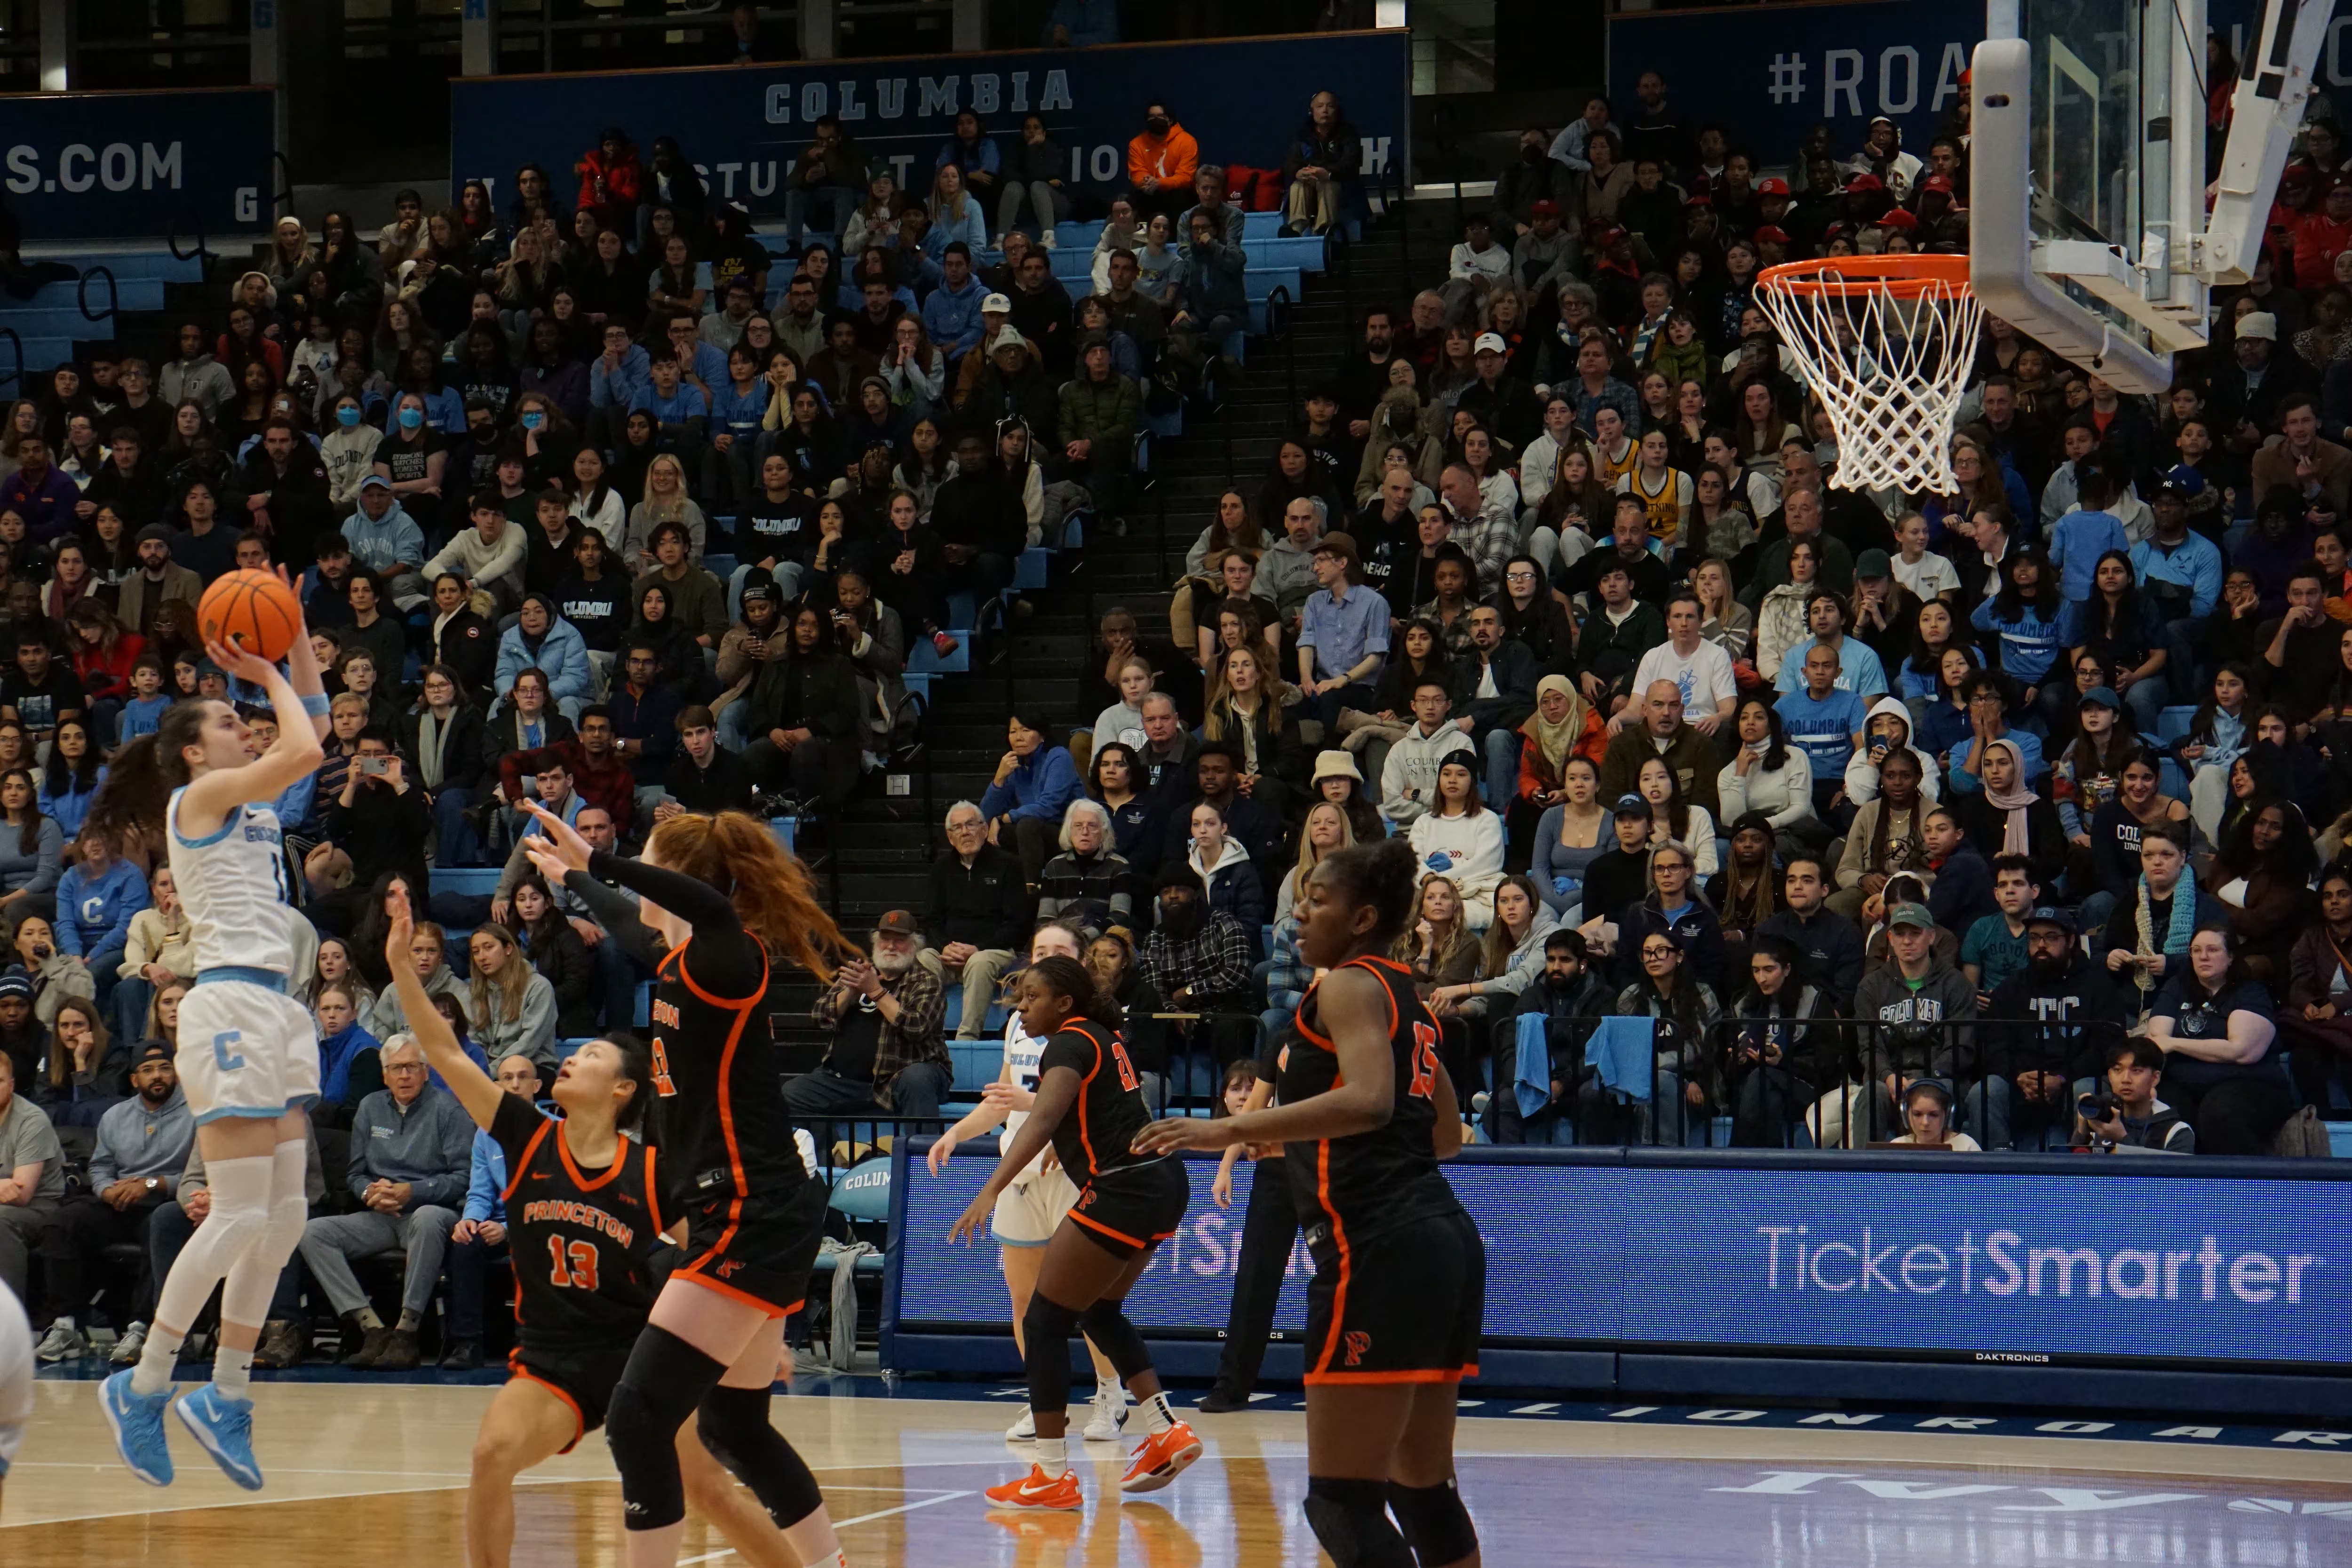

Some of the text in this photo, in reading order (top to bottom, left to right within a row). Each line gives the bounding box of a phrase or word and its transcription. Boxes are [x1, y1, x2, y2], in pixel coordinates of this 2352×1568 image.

[766, 69, 1073, 124] COLUMBIA
[6, 141, 183, 194] S.COM
[234, 187, 258, 223] G
[1788, 718, 1845, 735] COLUMBIA
[892, 779, 904, 795] H
[82, 897, 103, 923] C
[214, 1031, 245, 1071] C
[1408, 1020, 1439, 1102] 15
[523, 1199, 634, 1250] PRINCETON
[547, 1233, 599, 1292] 13
[1758, 1225, 2314, 1303] TicketSmarter
[1976, 1353, 2050, 1362] DAKTRONICS
